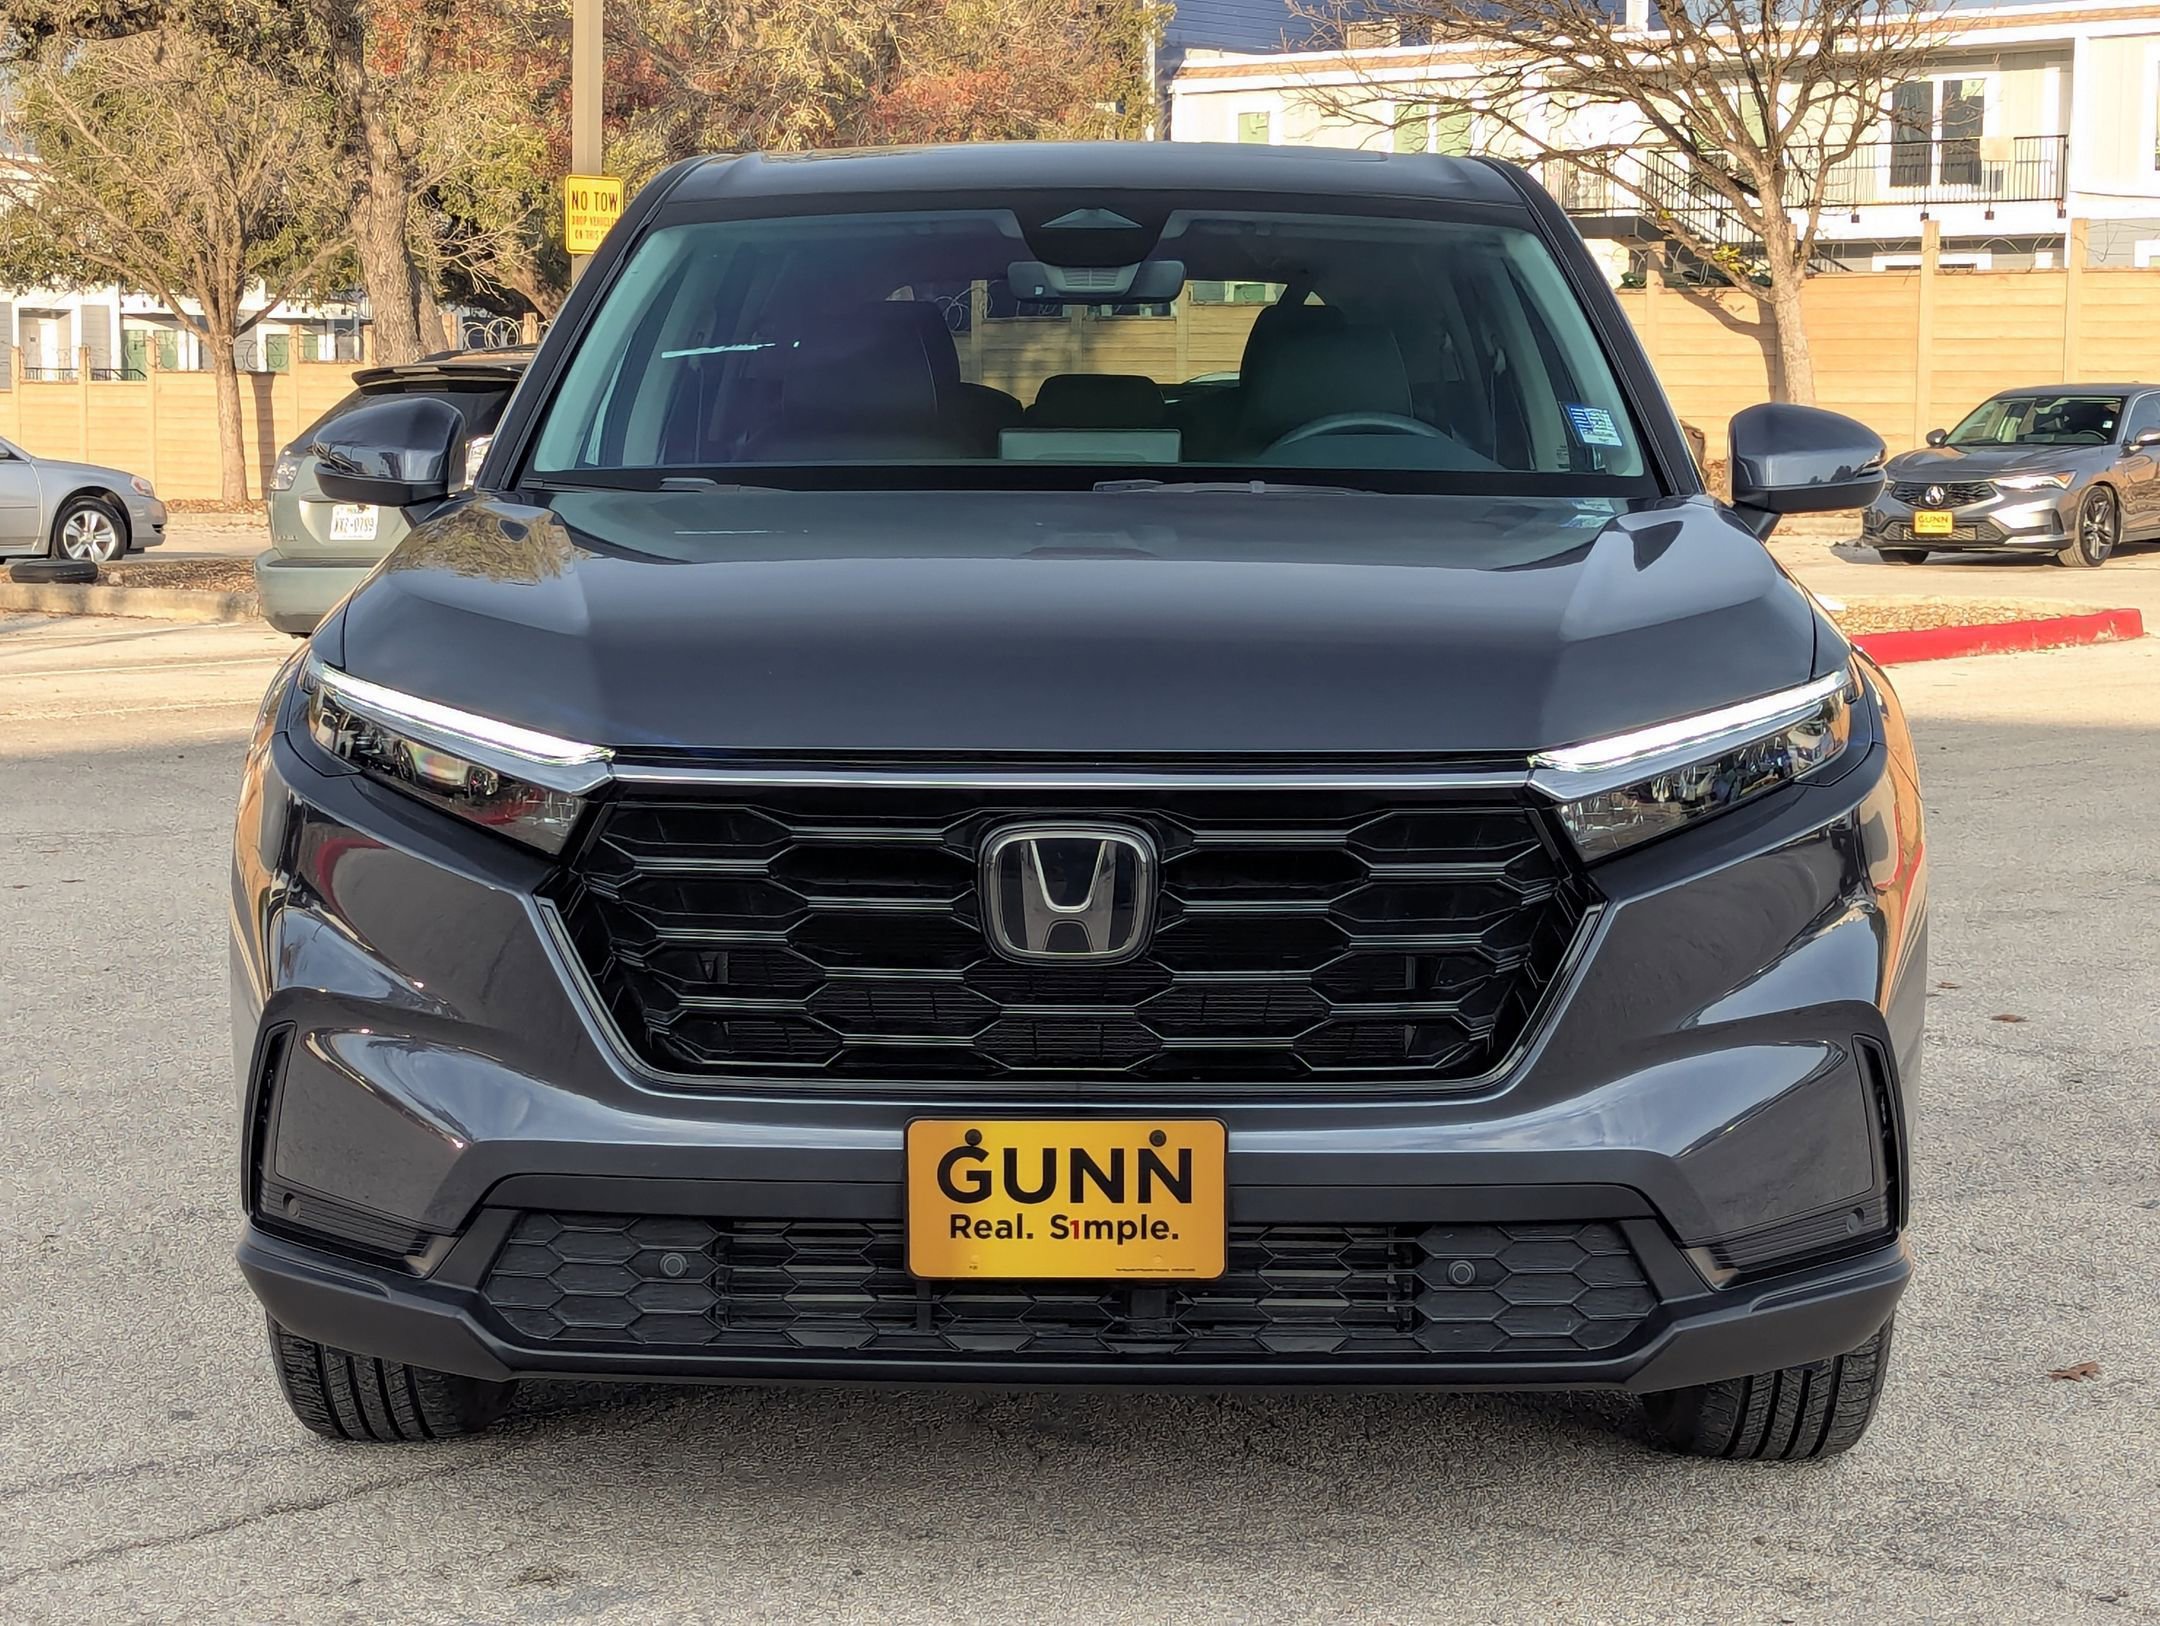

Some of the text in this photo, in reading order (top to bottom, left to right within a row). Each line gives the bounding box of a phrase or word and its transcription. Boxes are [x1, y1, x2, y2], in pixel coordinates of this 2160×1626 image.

[571, 190, 618, 212] NO TOW
[936, 1145, 1193, 1205] GUNN
[950, 1212, 1034, 1240] Real.
